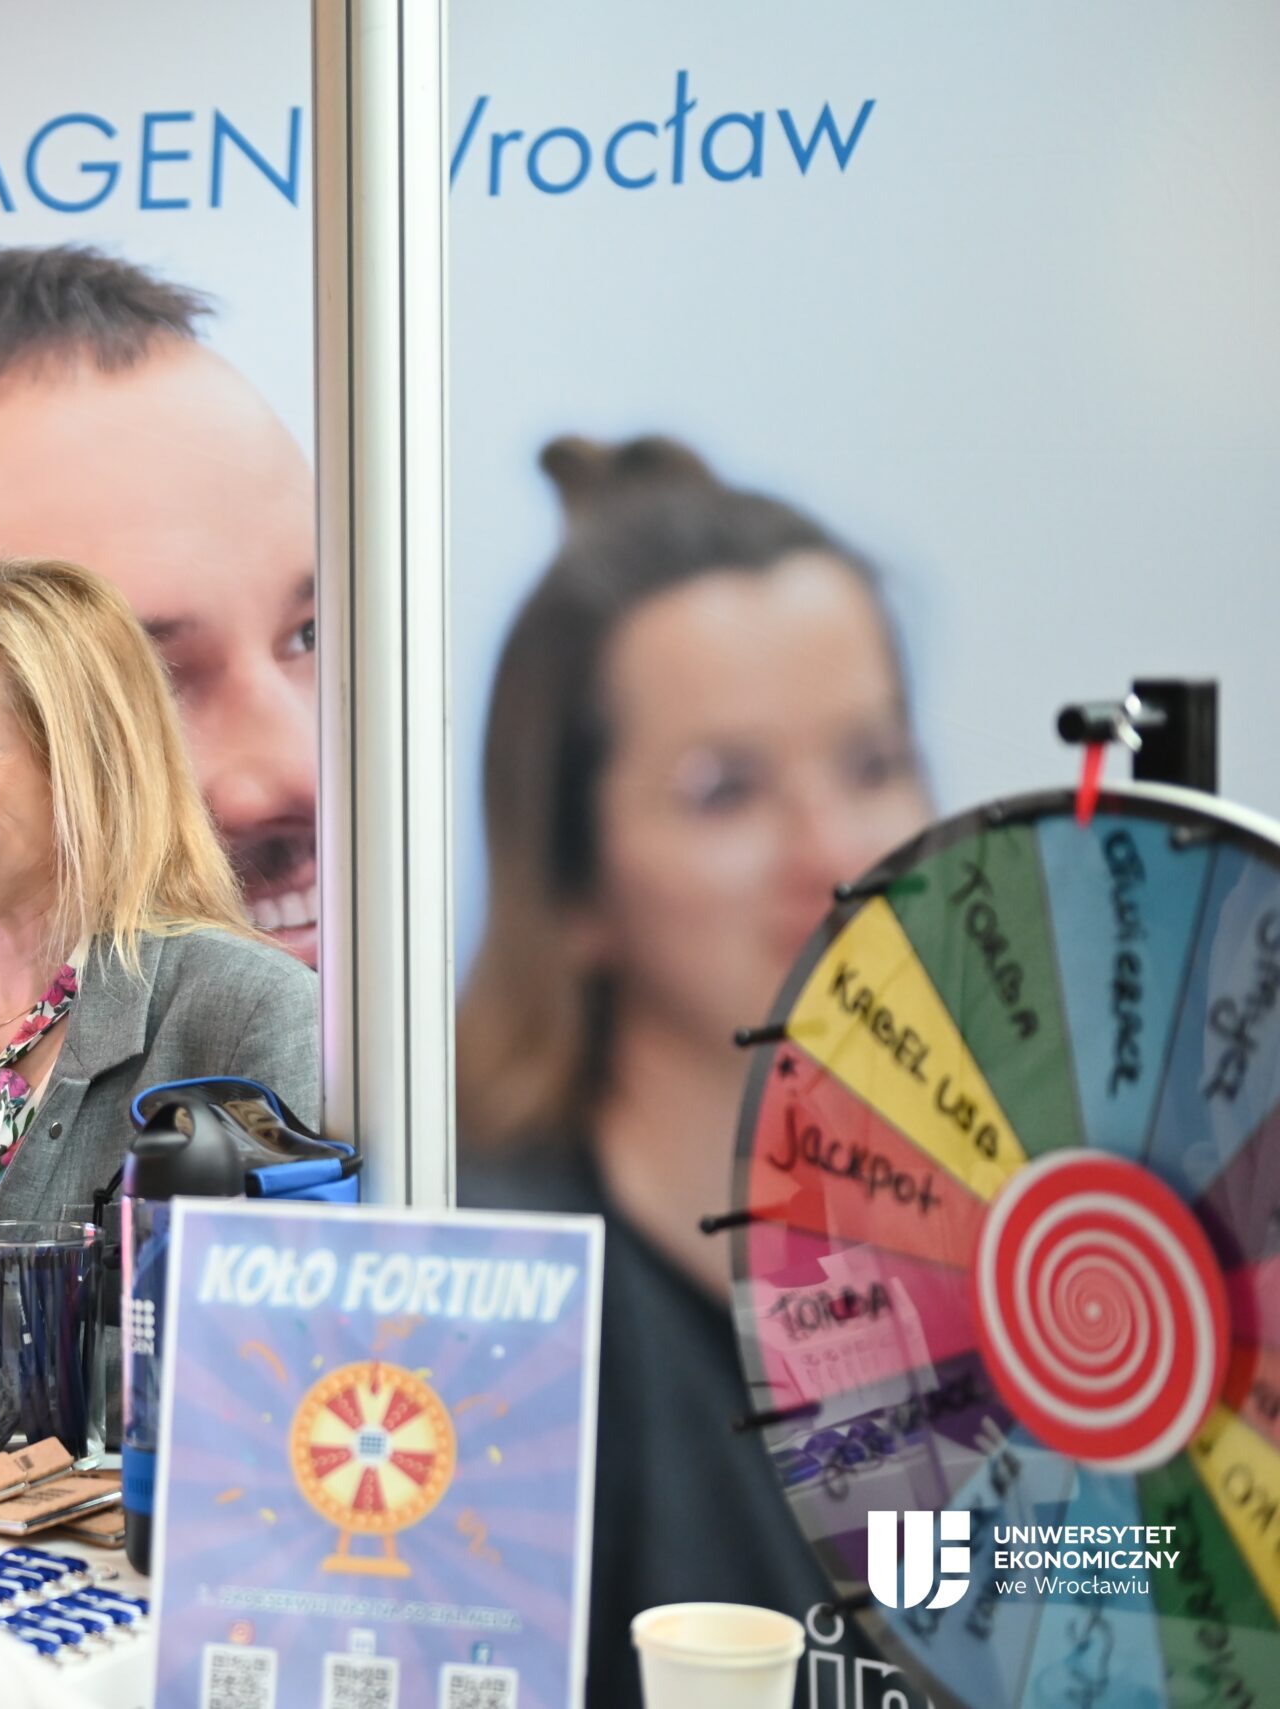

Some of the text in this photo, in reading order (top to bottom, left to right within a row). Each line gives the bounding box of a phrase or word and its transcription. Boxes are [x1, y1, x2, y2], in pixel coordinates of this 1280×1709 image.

[828, 961, 1002, 1160] KABEL USB
[198, 1243, 579, 1324] KOŁO FORTUNY
